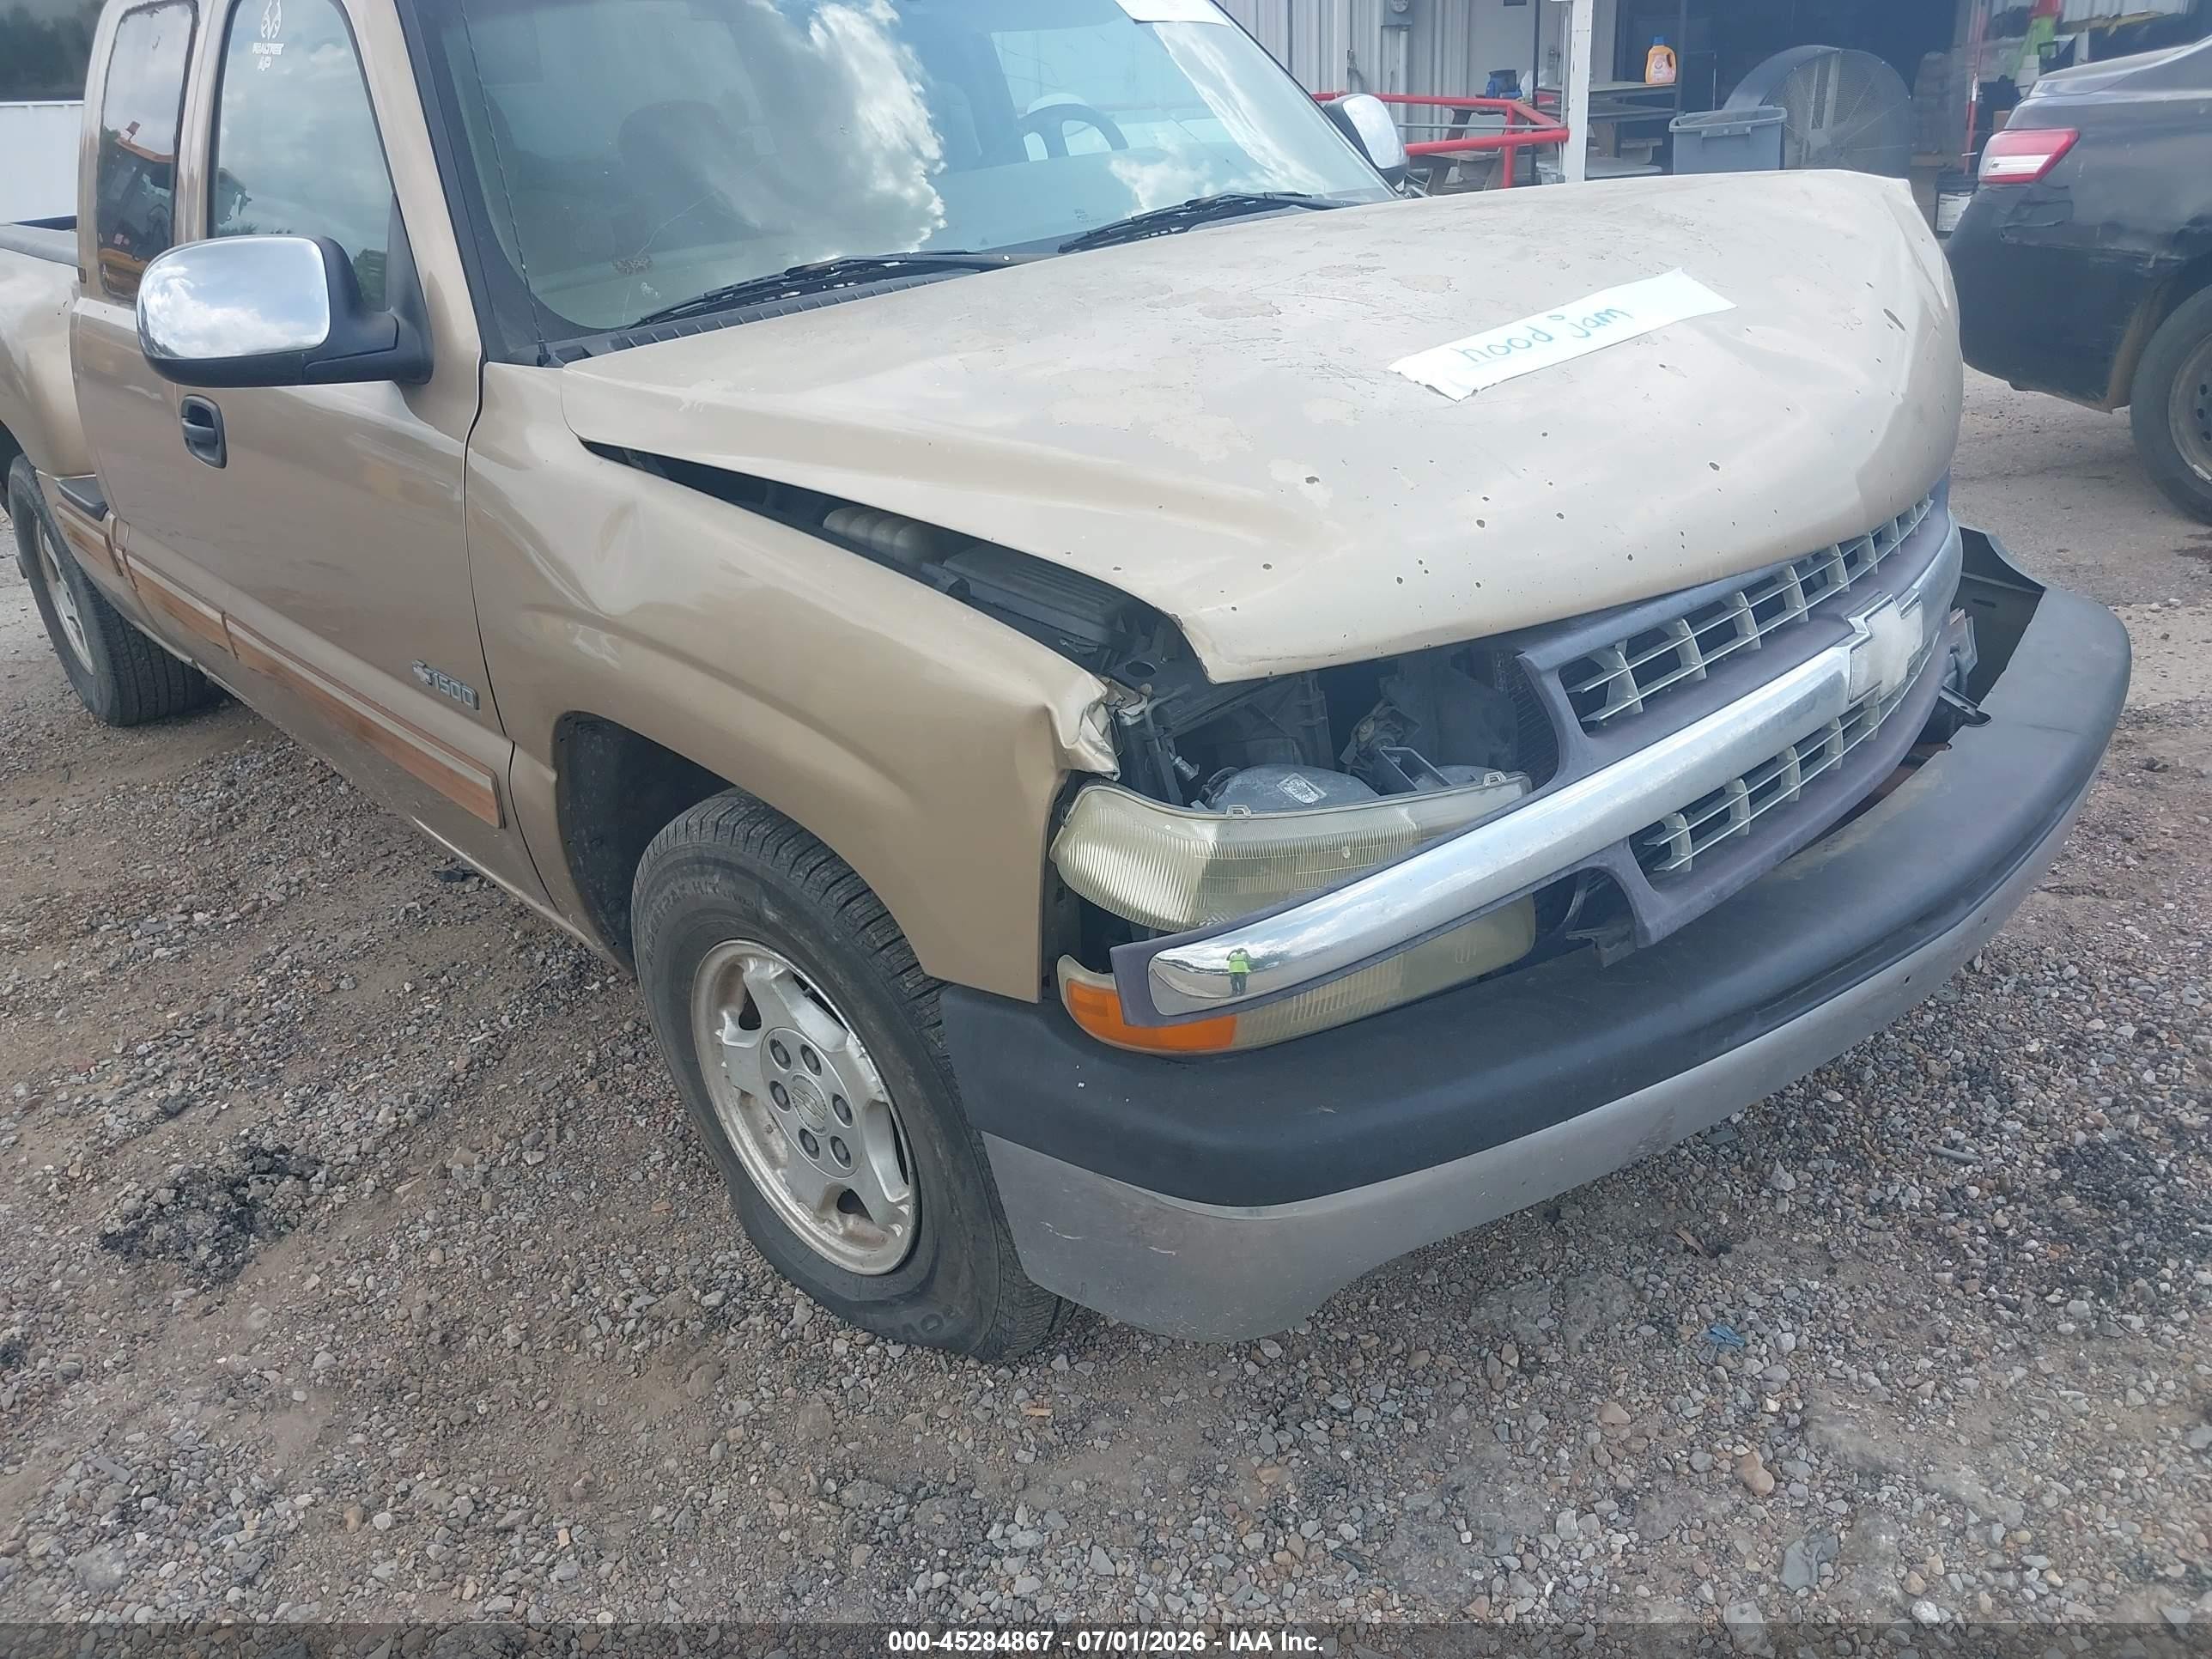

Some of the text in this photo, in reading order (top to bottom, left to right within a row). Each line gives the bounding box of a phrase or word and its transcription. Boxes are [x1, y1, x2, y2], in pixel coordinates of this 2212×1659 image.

[1449, 307, 1634, 362] hood jam
[433, 672, 475, 708] 1500
